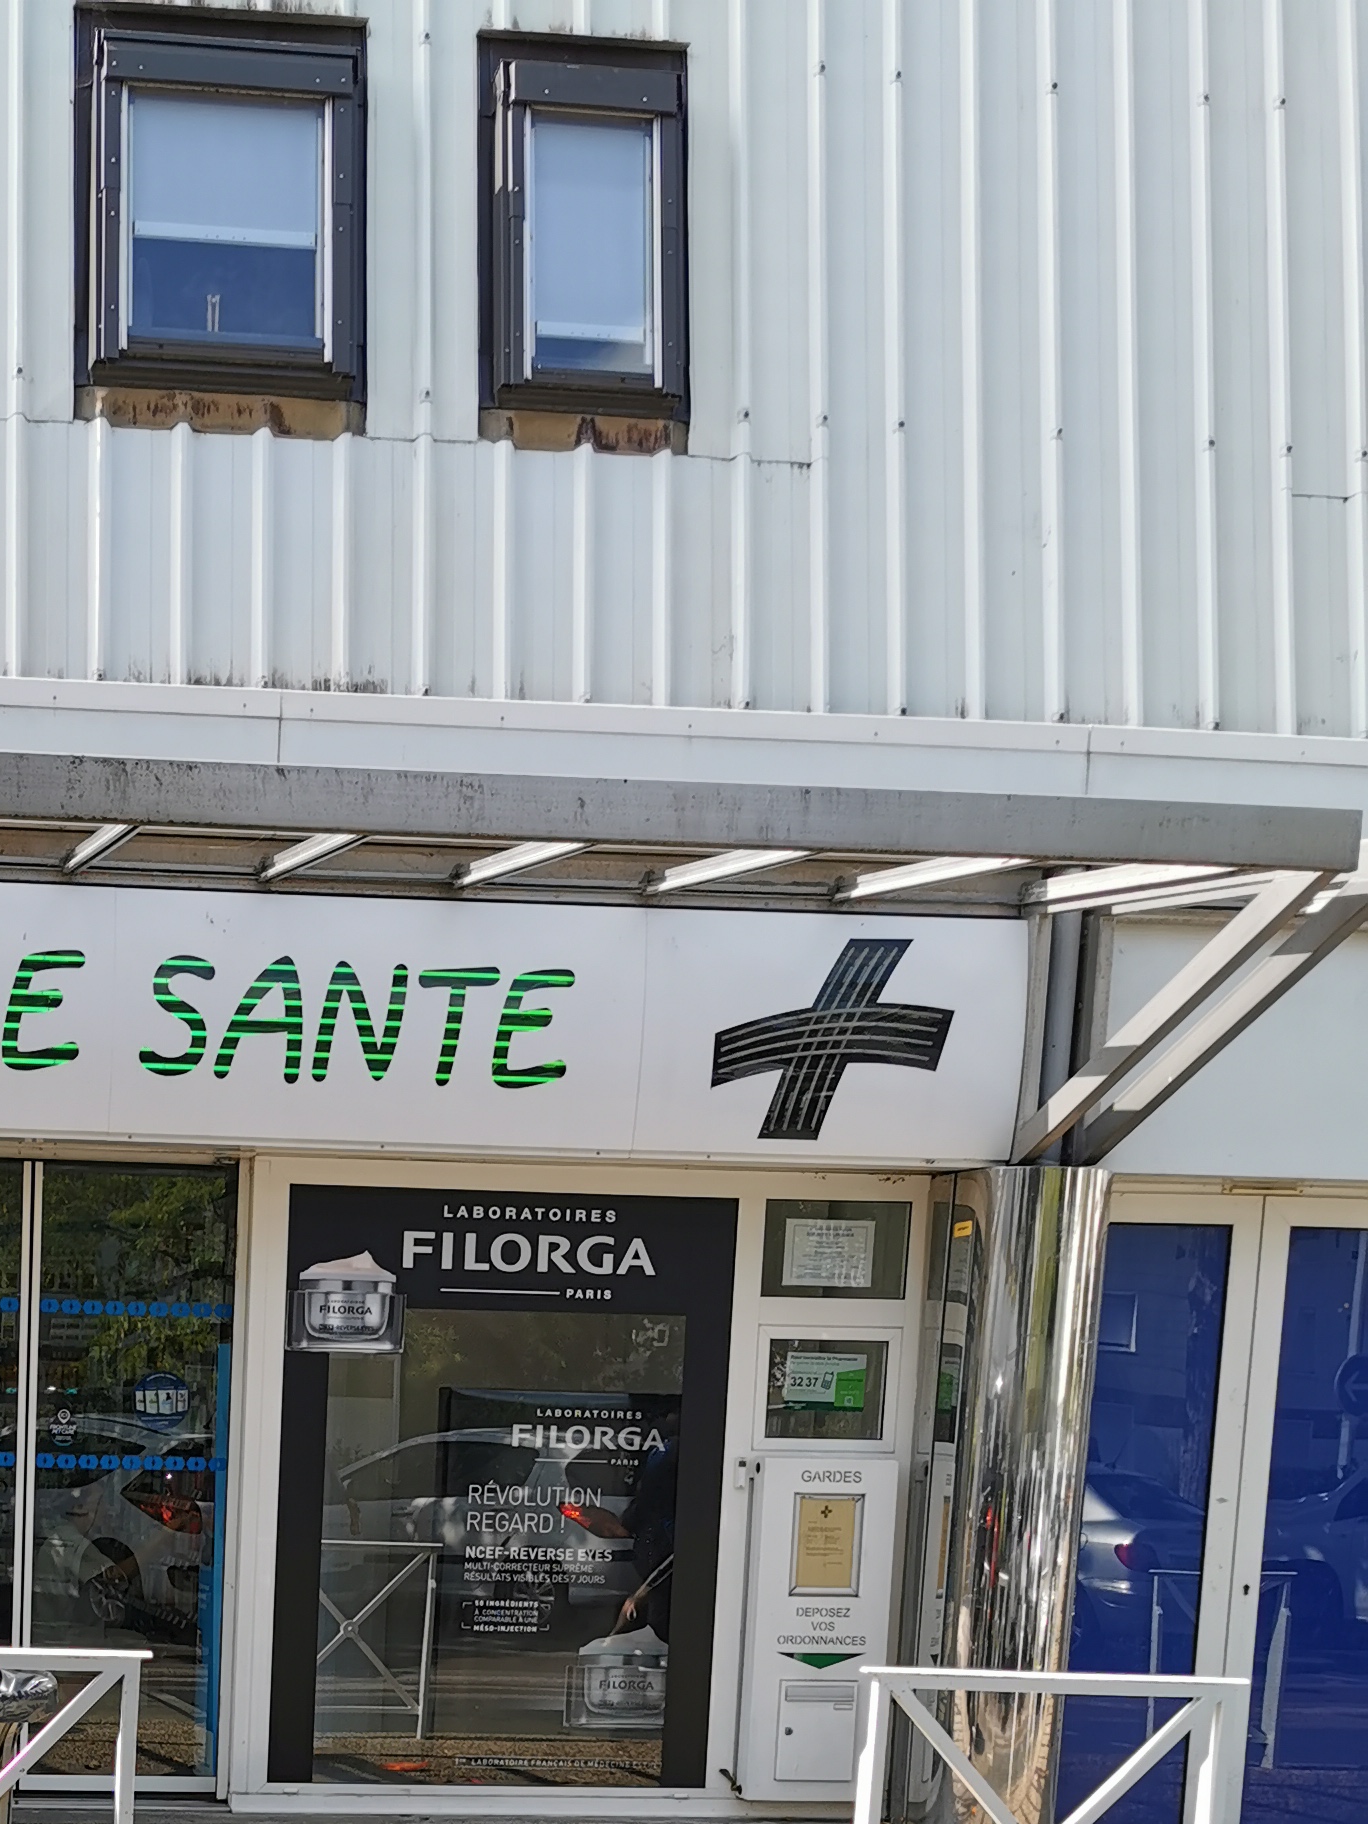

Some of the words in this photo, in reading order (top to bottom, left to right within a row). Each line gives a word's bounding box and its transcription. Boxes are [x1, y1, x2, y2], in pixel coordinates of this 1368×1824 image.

[139, 955, 575, 1088] SANTE
[443, 1204, 618, 1223] LABORATOIRES
[401, 1230, 656, 1277] FILORGA
[566, 1288, 613, 1300] PARIS
[319, 1304, 373, 1315] FILORGA
[790, 1376, 803, 1387] 32
[805, 1377, 819, 1387] 37
[536, 1407, 643, 1420] LABORATOIRES
[511, 1424, 666, 1452] FILORGA
[610, 1458, 639, 1467] PARIS
[801, 1470, 862, 1483] GARDES
[468, 1480, 601, 1508] RÉVOLUTION
[466, 1511, 554, 1534] REGARD
[560, 1513, 566, 1533] !
[465, 1546, 574, 1560] NCEF-REVERSE
[577, 1549, 613, 1562] EYES
[464, 1562, 551, 1571] MULTI-CORRECTEUR
[552, 1562, 594, 1573] SUPRÊME
[463, 1571, 511, 1581] RÉSULTATS
[512, 1573, 550, 1583] VISIBLES
[552, 1573, 569, 1583] DÈS
[577, 1575, 606, 1584] JOURS
[486, 1600, 539, 1608] INGRÉDIENTS
[473, 1608, 480, 1616] À
[796, 1607, 851, 1617] DEPOSEZ
[473, 1624, 538, 1632] MÉSO-INJECTION
[811, 1621, 835, 1631] VOS
[777, 1634, 867, 1646] ORDONNANCES
[599, 1680, 654, 1691] FILORGA
[471, 1757, 528, 1766] LABORATOIRE
[531, 1758, 572, 1768] FRANÇAIS
[587, 1758, 630, 1769] MÉDECINE
